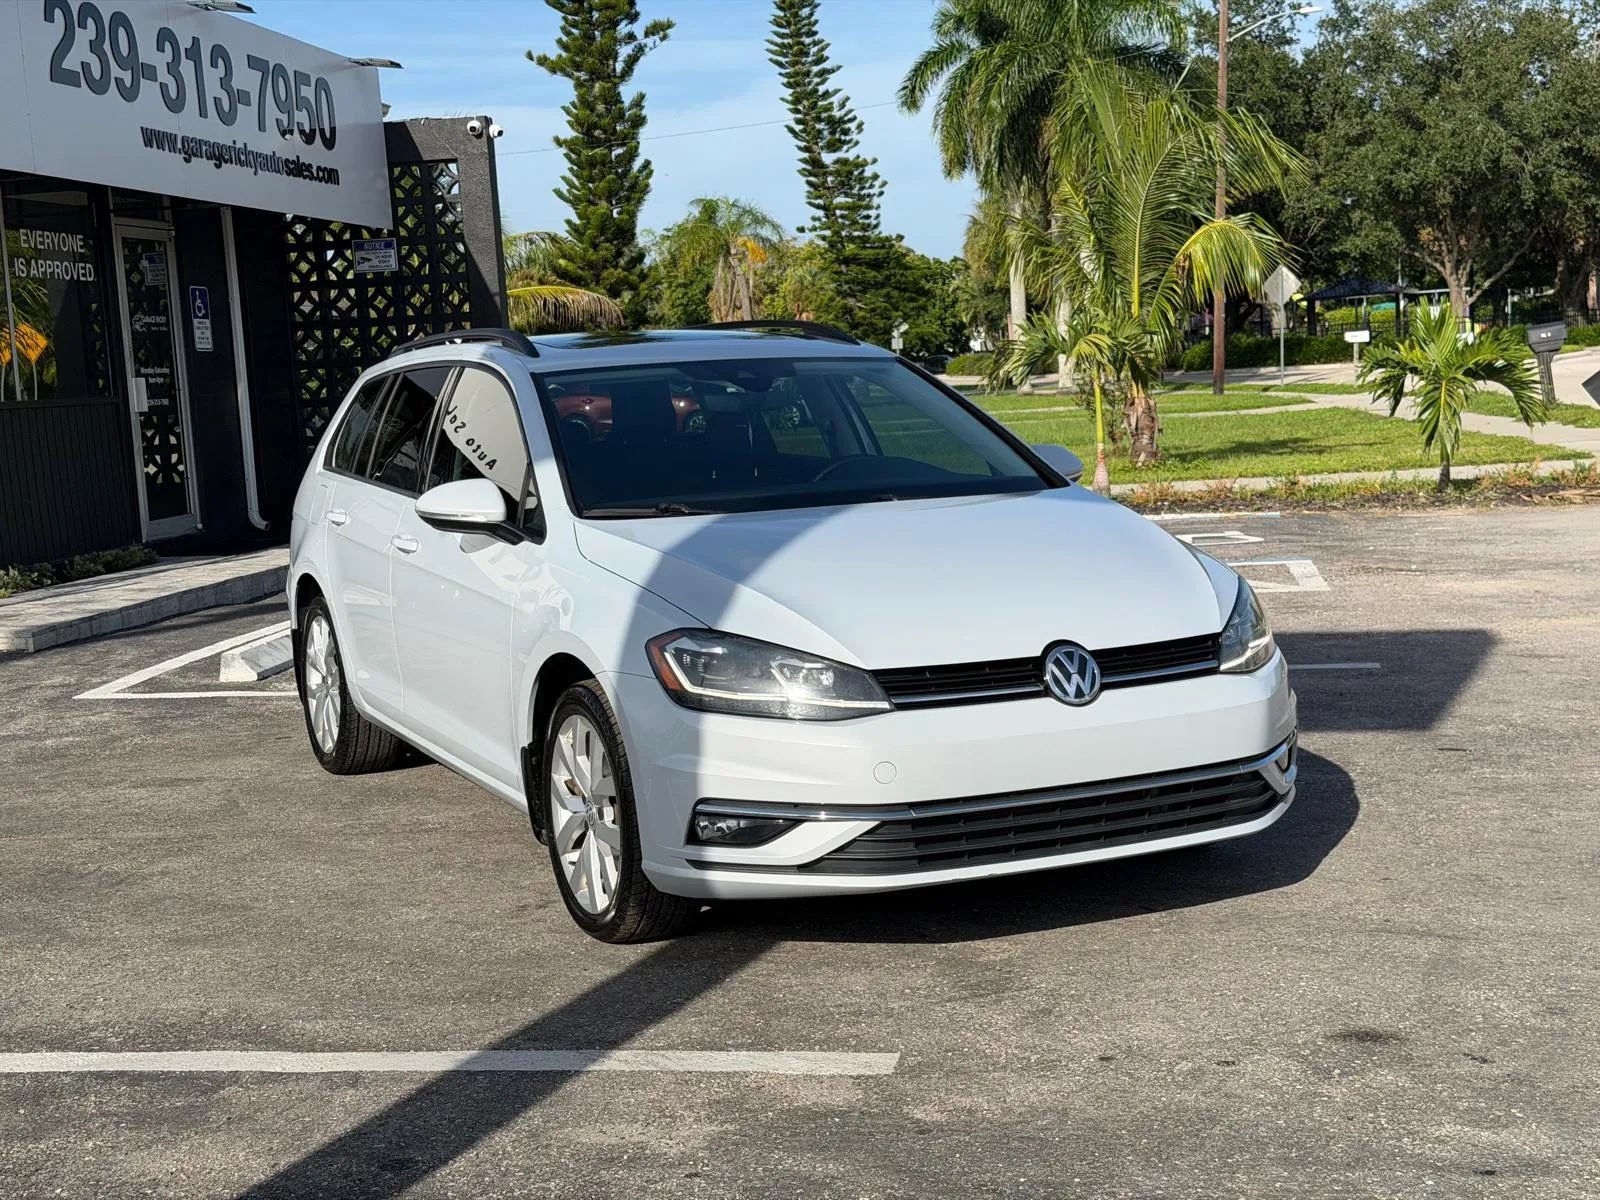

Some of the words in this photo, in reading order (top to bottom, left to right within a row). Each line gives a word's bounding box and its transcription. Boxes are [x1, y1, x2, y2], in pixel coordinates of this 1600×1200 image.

[44, 0, 337, 151] 239-313-7950
[140, 126, 340, 186] www.garagerickyautosales.com
[19, 228, 85, 253] EVERYONE
[363, 242, 384, 250] NOTICE
[14, 257, 28, 278] IS
